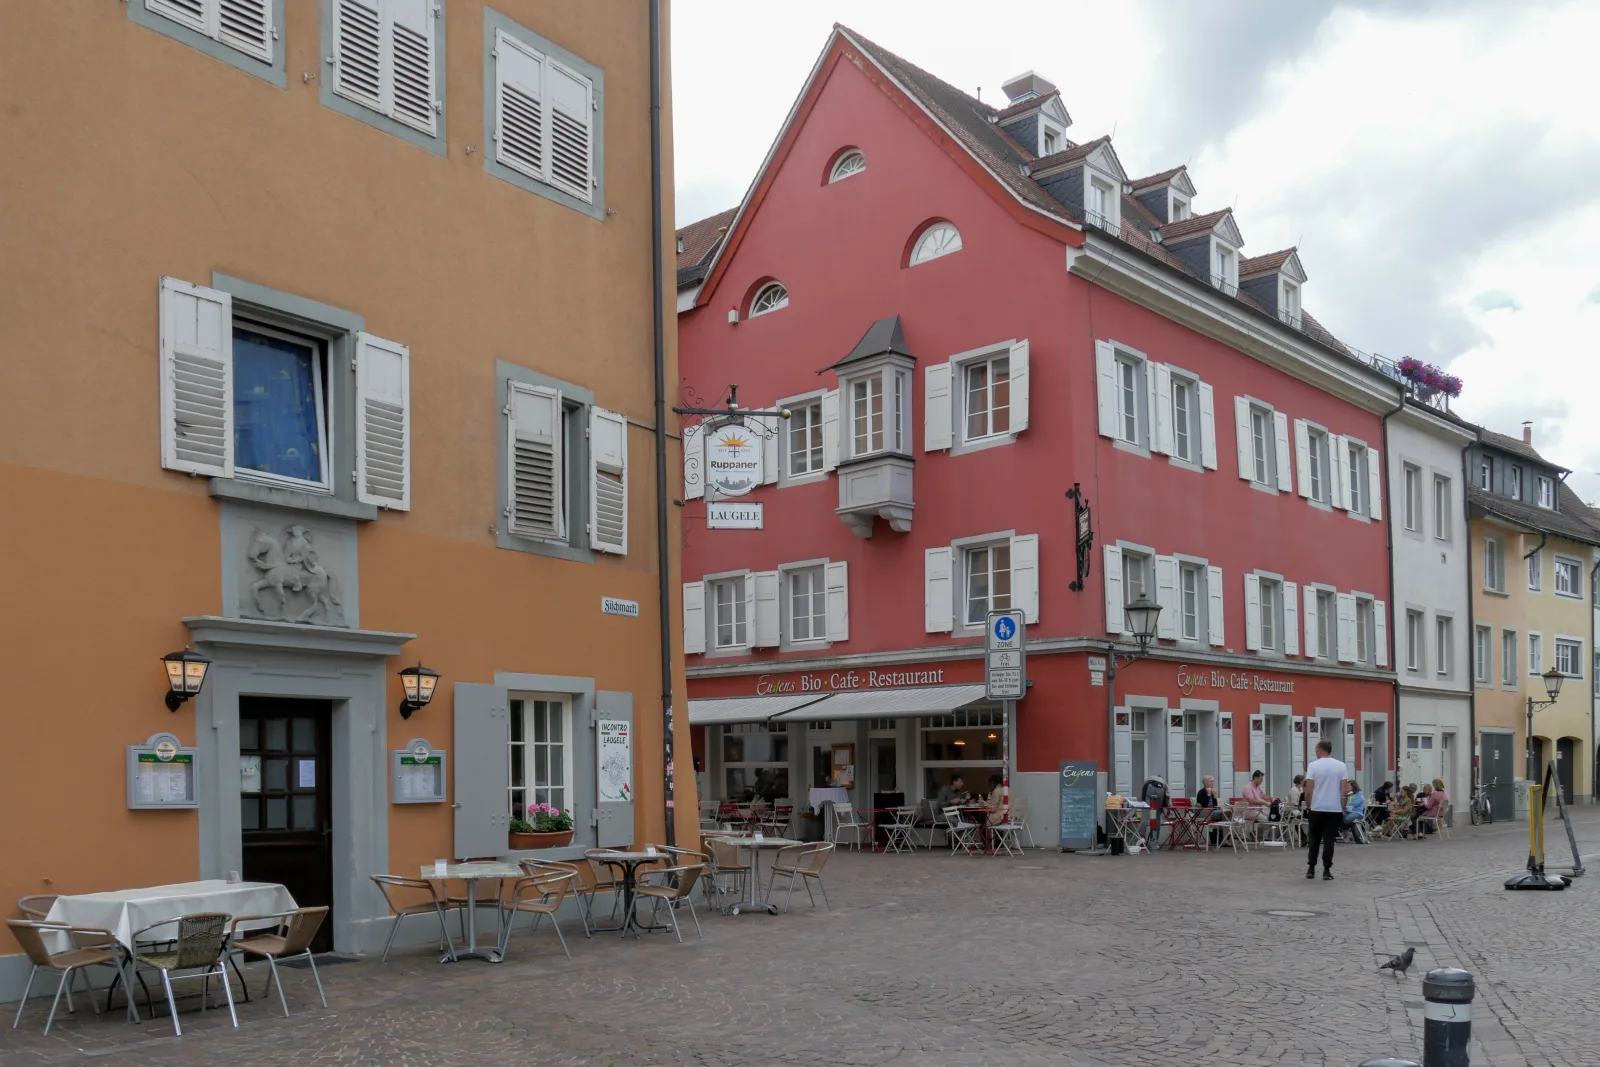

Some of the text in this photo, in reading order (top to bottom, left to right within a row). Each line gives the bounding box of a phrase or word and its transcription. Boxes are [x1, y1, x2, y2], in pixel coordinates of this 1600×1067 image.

[710, 460, 758, 469] Ruppaner
[710, 511, 760, 521] LAUGELE
[756, 668, 944, 696] Eugens Bio Cafe Restaurant
[1177, 664, 1295, 696] Eugens Bio Cafe Restaurant
[601, 723, 628, 732] INCONTRO
[603, 736, 626, 745] LAUGELE
[1062, 765, 1095, 787] Eugens
